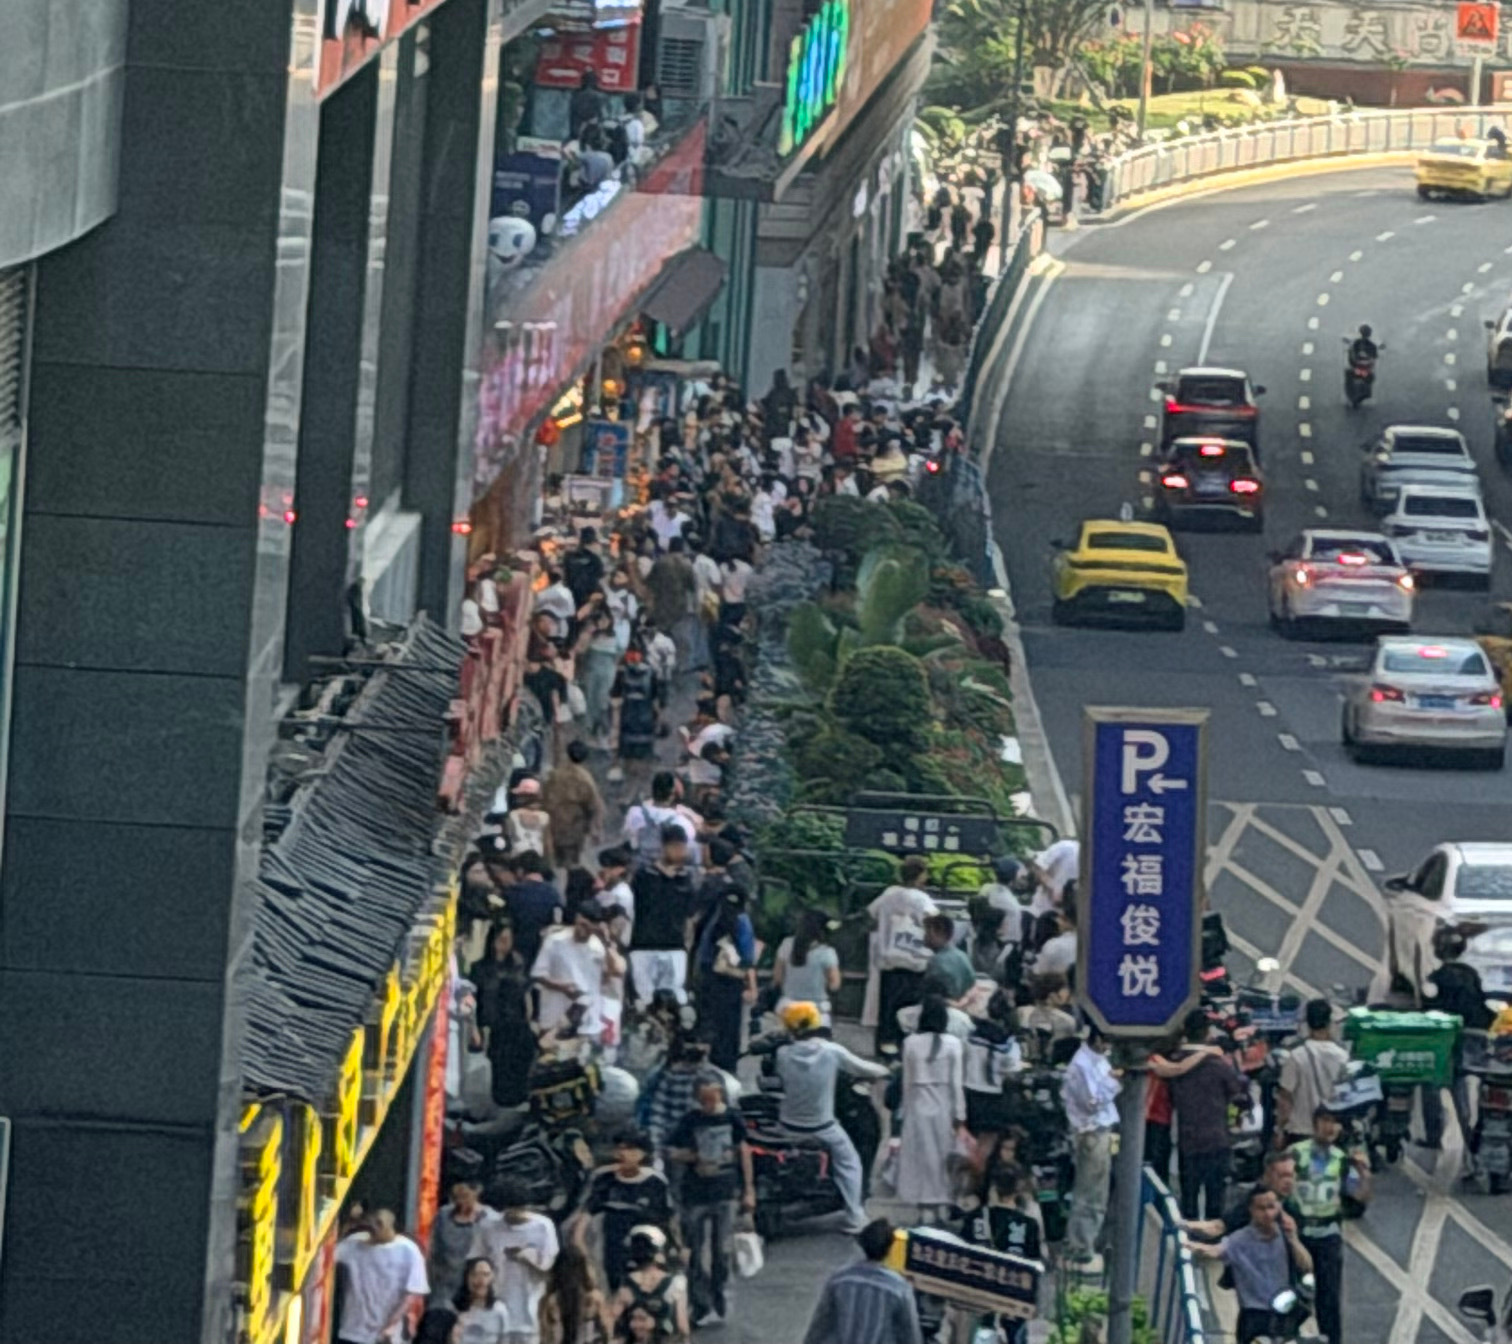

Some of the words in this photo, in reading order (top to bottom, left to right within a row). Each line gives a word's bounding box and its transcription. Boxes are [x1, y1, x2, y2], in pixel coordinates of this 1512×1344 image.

[1121, 729, 1170, 795] P
[1118, 802, 1165, 998] 宏福俊悦
